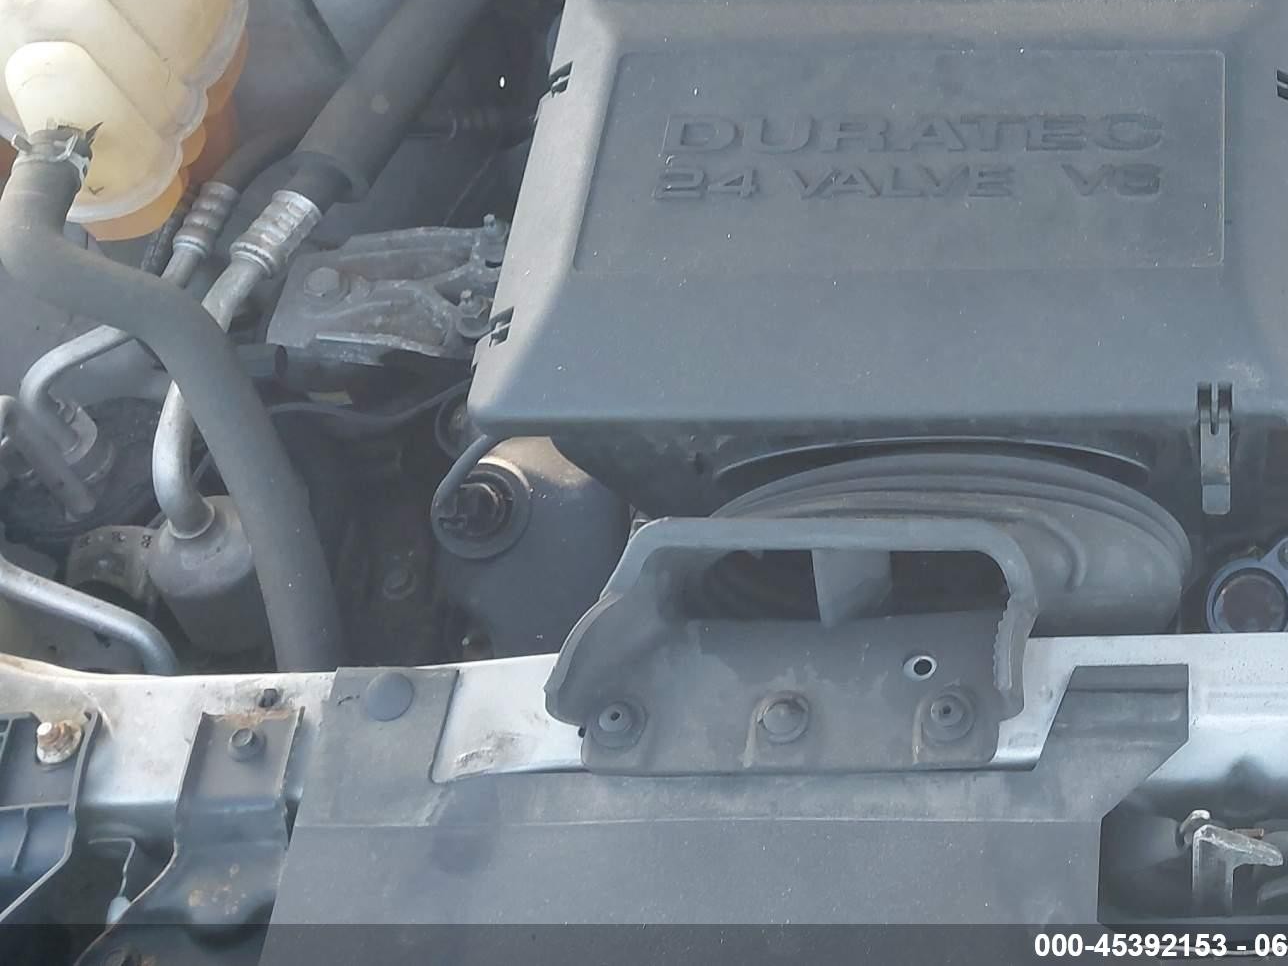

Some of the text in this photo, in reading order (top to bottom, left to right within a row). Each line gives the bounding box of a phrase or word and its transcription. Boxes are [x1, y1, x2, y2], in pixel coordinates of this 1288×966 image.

[659, 113, 1164, 154] DURATEC
[652, 162, 1164, 201] 24 VALVE V6
